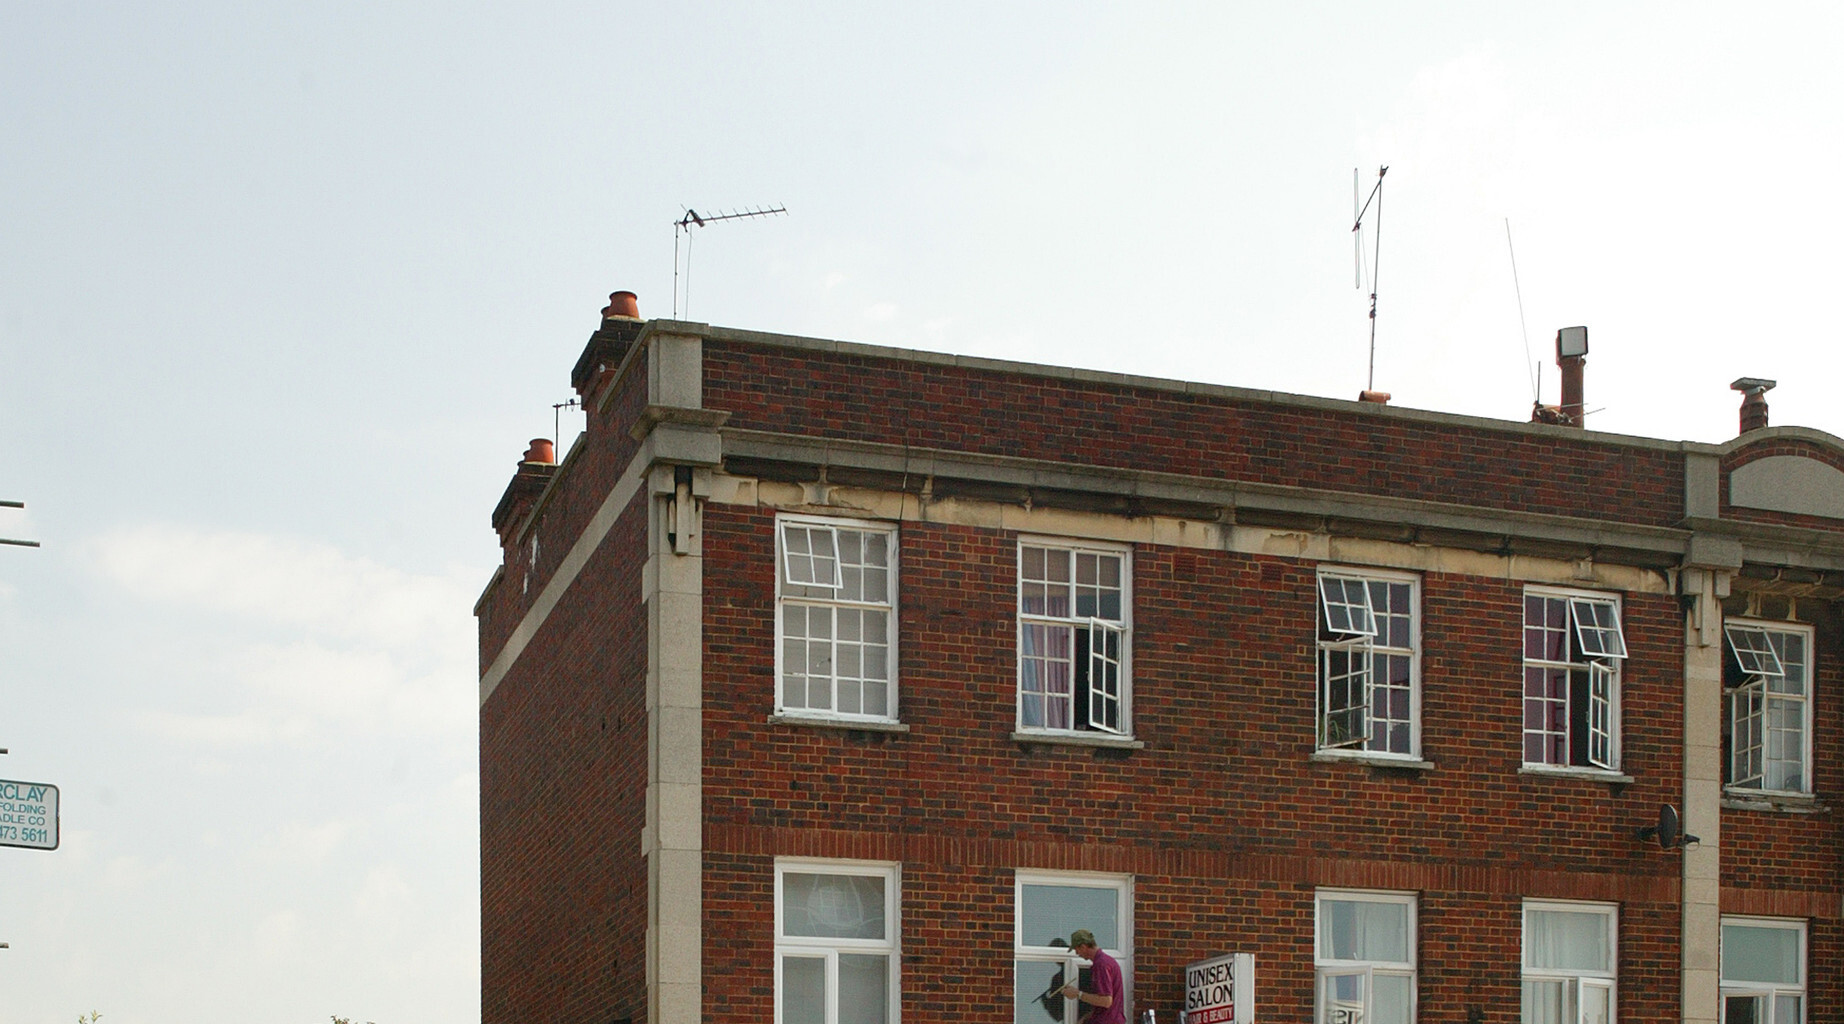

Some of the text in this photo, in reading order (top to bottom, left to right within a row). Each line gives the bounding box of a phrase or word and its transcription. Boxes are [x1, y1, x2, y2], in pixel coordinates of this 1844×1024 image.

[0, 814, 45, 825] DLE CO
[22, 828, 47, 843] 5611
[1189, 962, 1232, 988] UNISEX
[1189, 984, 1232, 1009] SALON
[1209, 1008, 1232, 1021] BEAUTY
